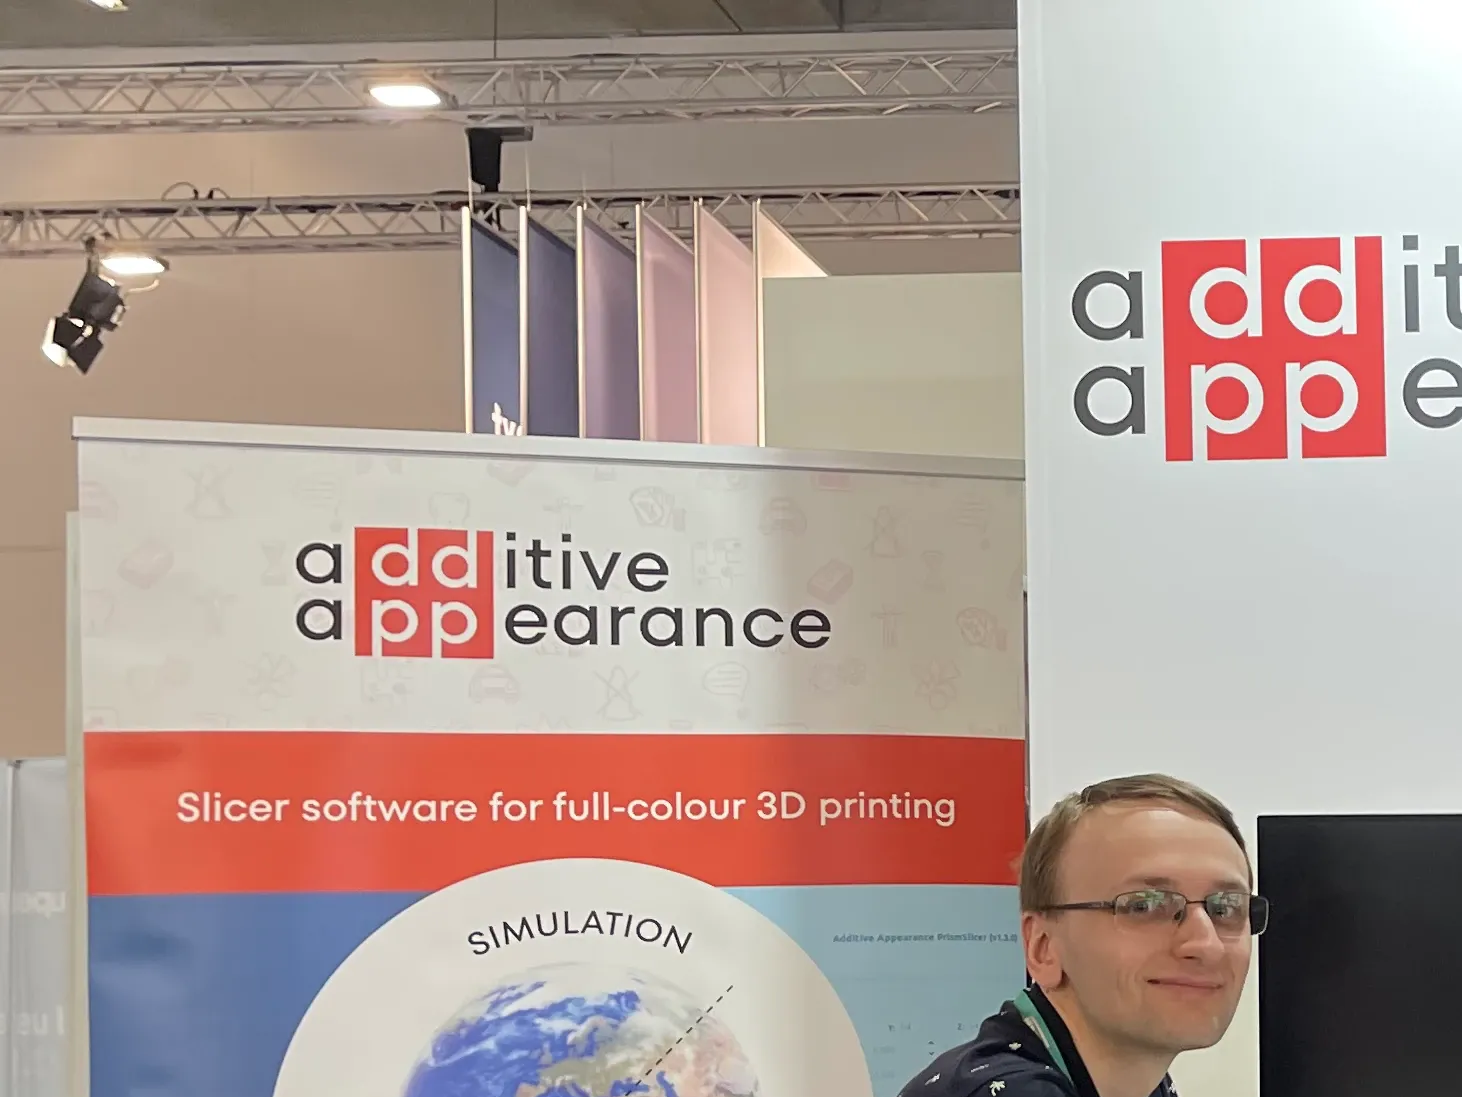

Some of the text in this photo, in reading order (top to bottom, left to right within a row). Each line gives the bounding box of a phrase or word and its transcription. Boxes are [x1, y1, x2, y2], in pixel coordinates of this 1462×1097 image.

[296, 526, 669, 593] additive
[296, 598, 832, 658] appearance
[176, 791, 956, 827] Slicer software for full-colour 3D printing
[468, 910, 693, 955] SIMULATION
[833, 933, 875, 943] Additive
[877, 932, 935, 943] Appearance
